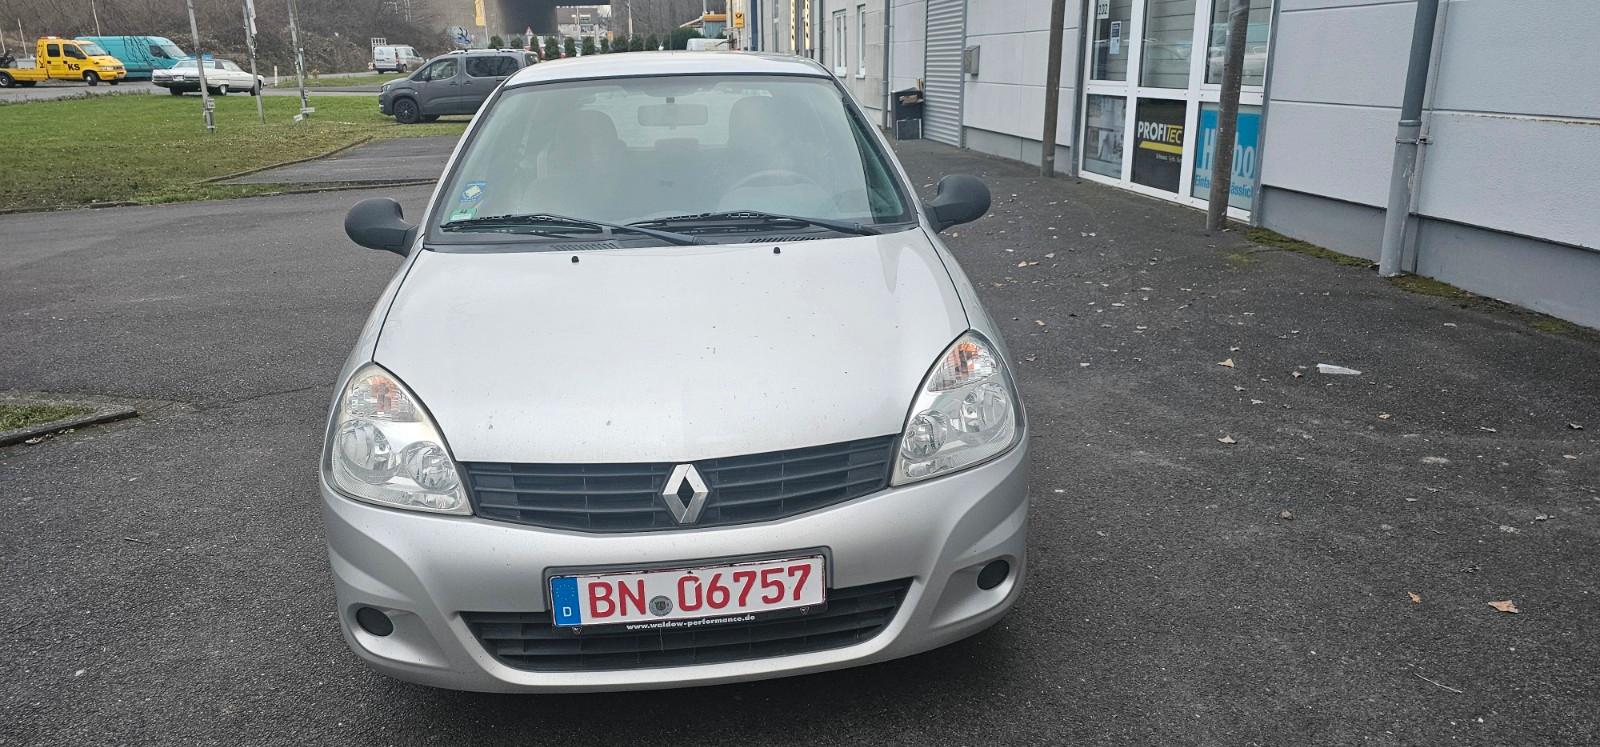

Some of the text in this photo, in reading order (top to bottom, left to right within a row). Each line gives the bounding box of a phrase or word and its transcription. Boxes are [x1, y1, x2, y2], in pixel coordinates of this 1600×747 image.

[1137, 120, 1183, 144] PROFITEC
[588, 579, 647, 618] BN
[677, 563, 812, 612] 06757
[563, 606, 571, 617] D
[626, 614, 756, 631] www.waldow-performance.de
